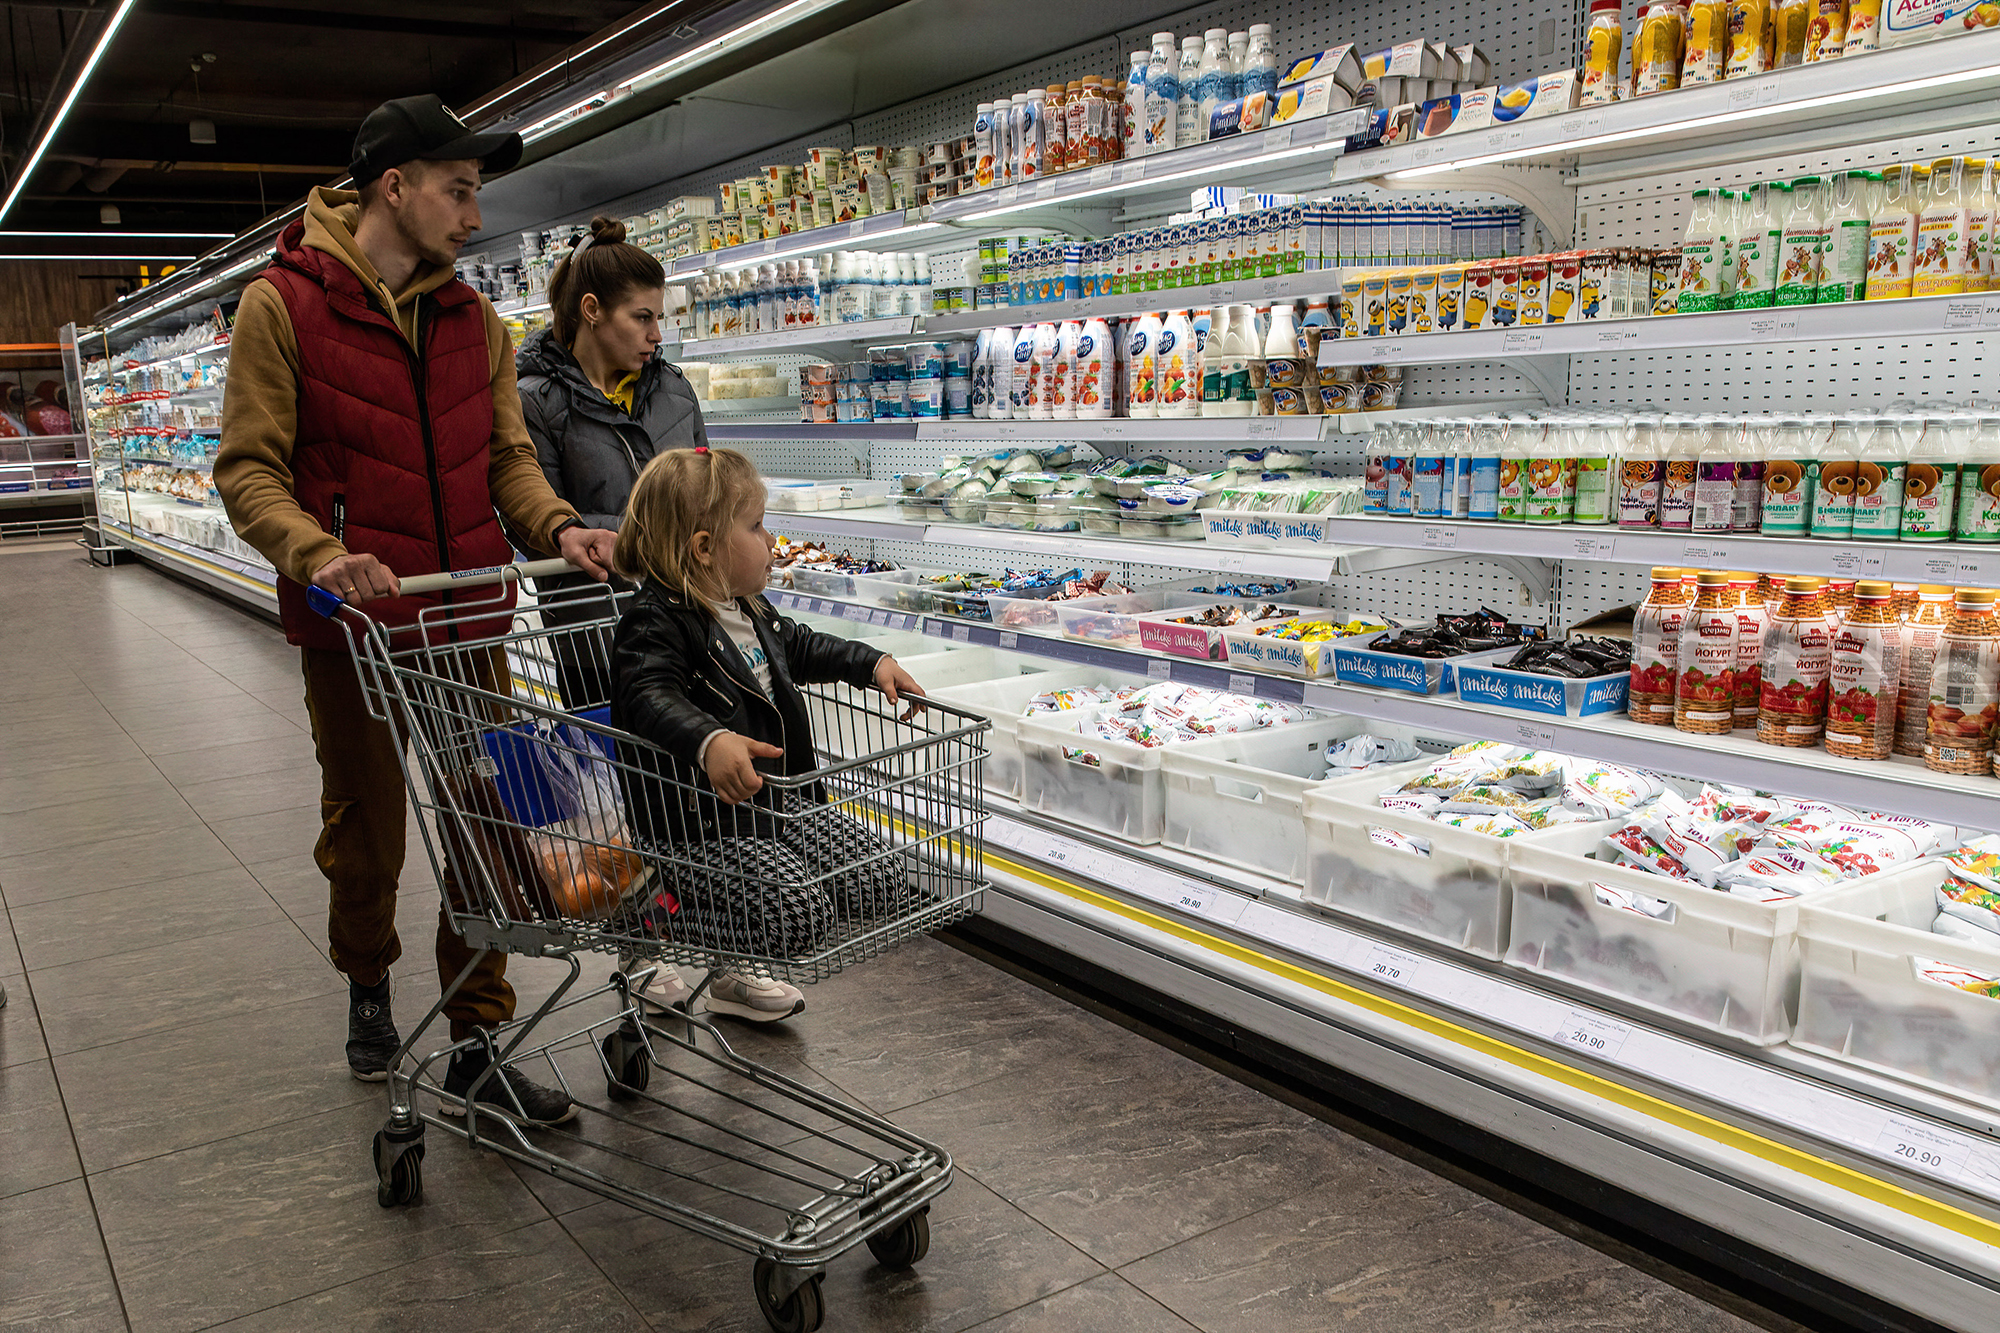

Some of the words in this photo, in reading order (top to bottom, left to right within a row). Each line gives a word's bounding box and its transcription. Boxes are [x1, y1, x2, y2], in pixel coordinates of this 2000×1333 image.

[1701, 626, 1730, 636] Ферма
[1695, 646, 1731, 658] ЙОГУРТ
[1048, 849, 1066, 861] 20.90
[1179, 896, 1202, 910] 20.90
[1373, 963, 1401, 979] 20.70
[1571, 1030, 1606, 1050] 20.90
[1893, 1143, 1942, 1167] 20.90
